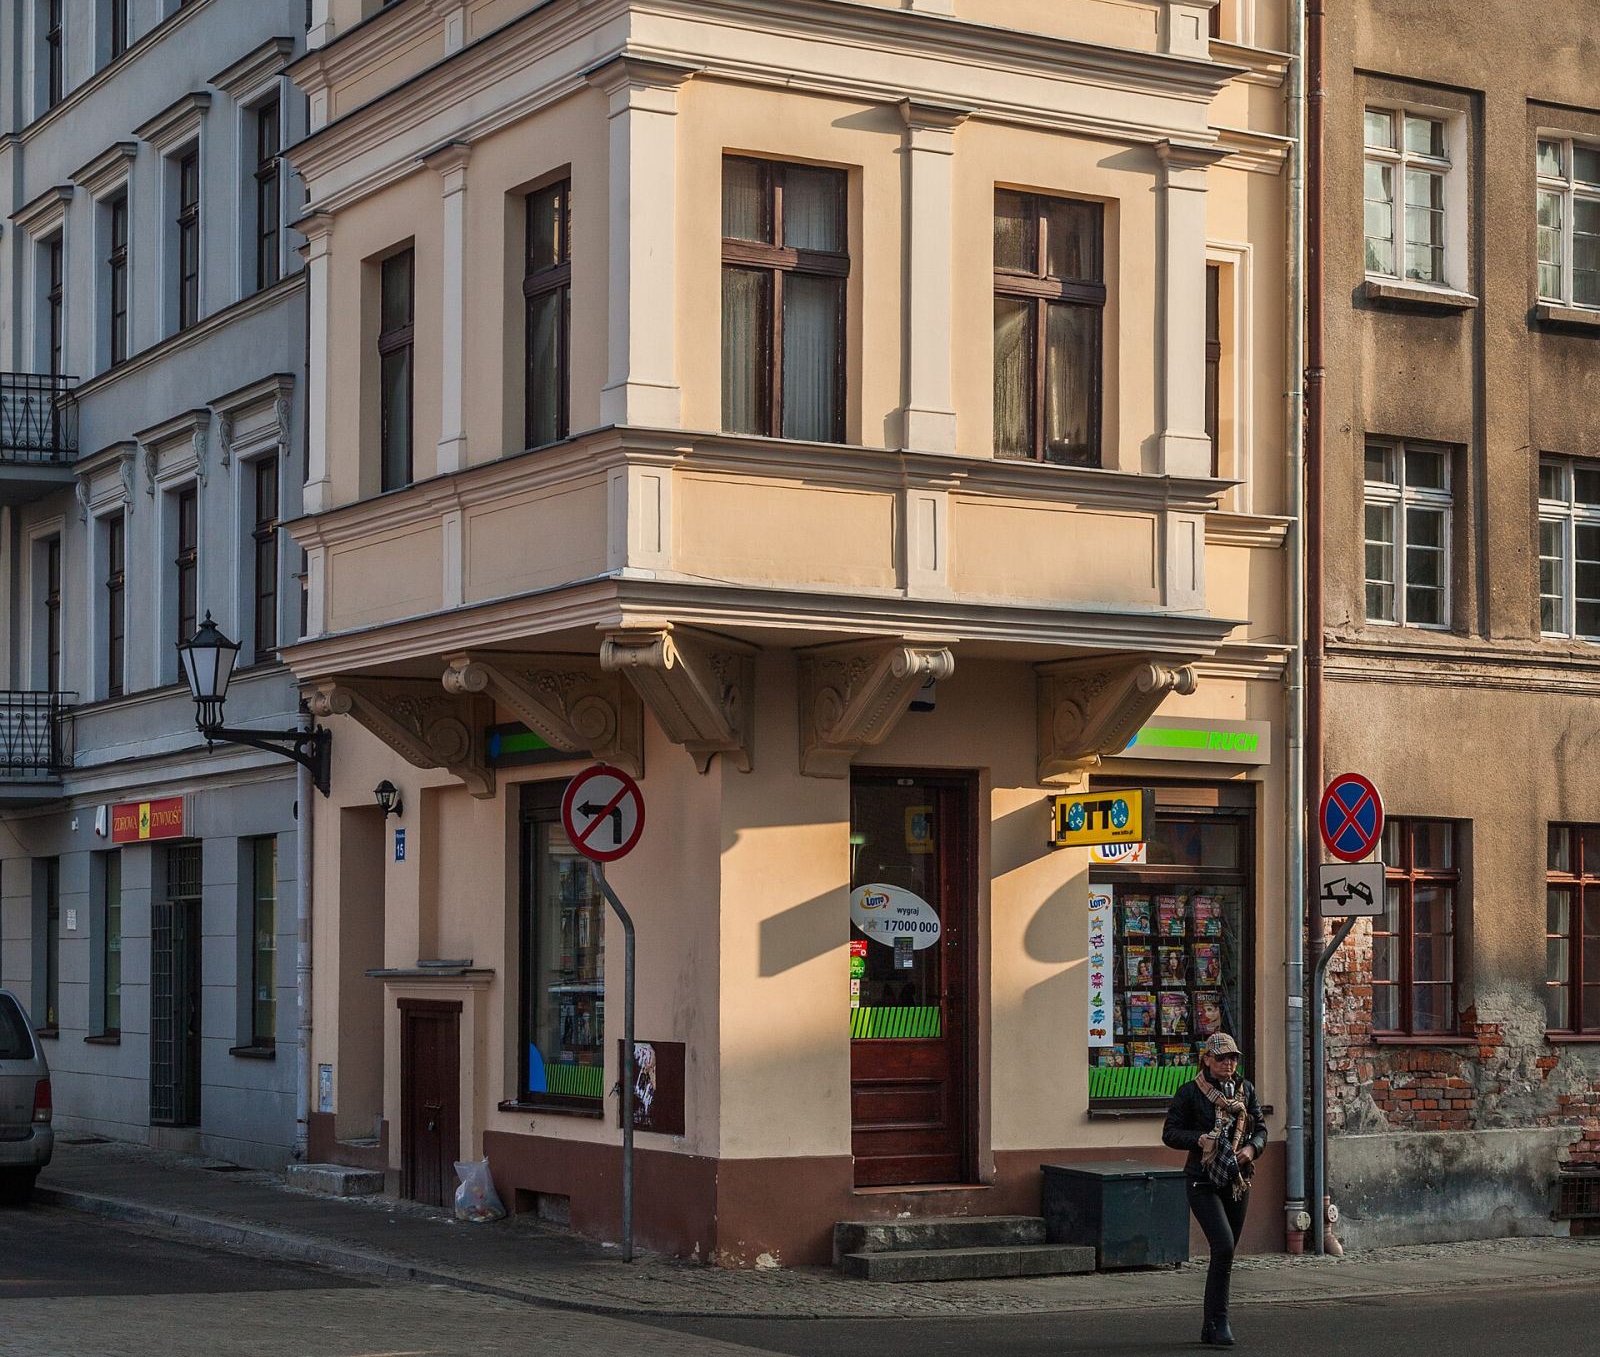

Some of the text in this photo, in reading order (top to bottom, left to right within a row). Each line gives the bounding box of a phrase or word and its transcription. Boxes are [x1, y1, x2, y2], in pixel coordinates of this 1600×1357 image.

[1208, 731, 1259, 751] RUCH
[1060, 799, 1129, 832] LOTTO
[397, 844, 404, 857] 15
[866, 896, 884, 907] LOTTO
[896, 907, 920, 917] wygraj
